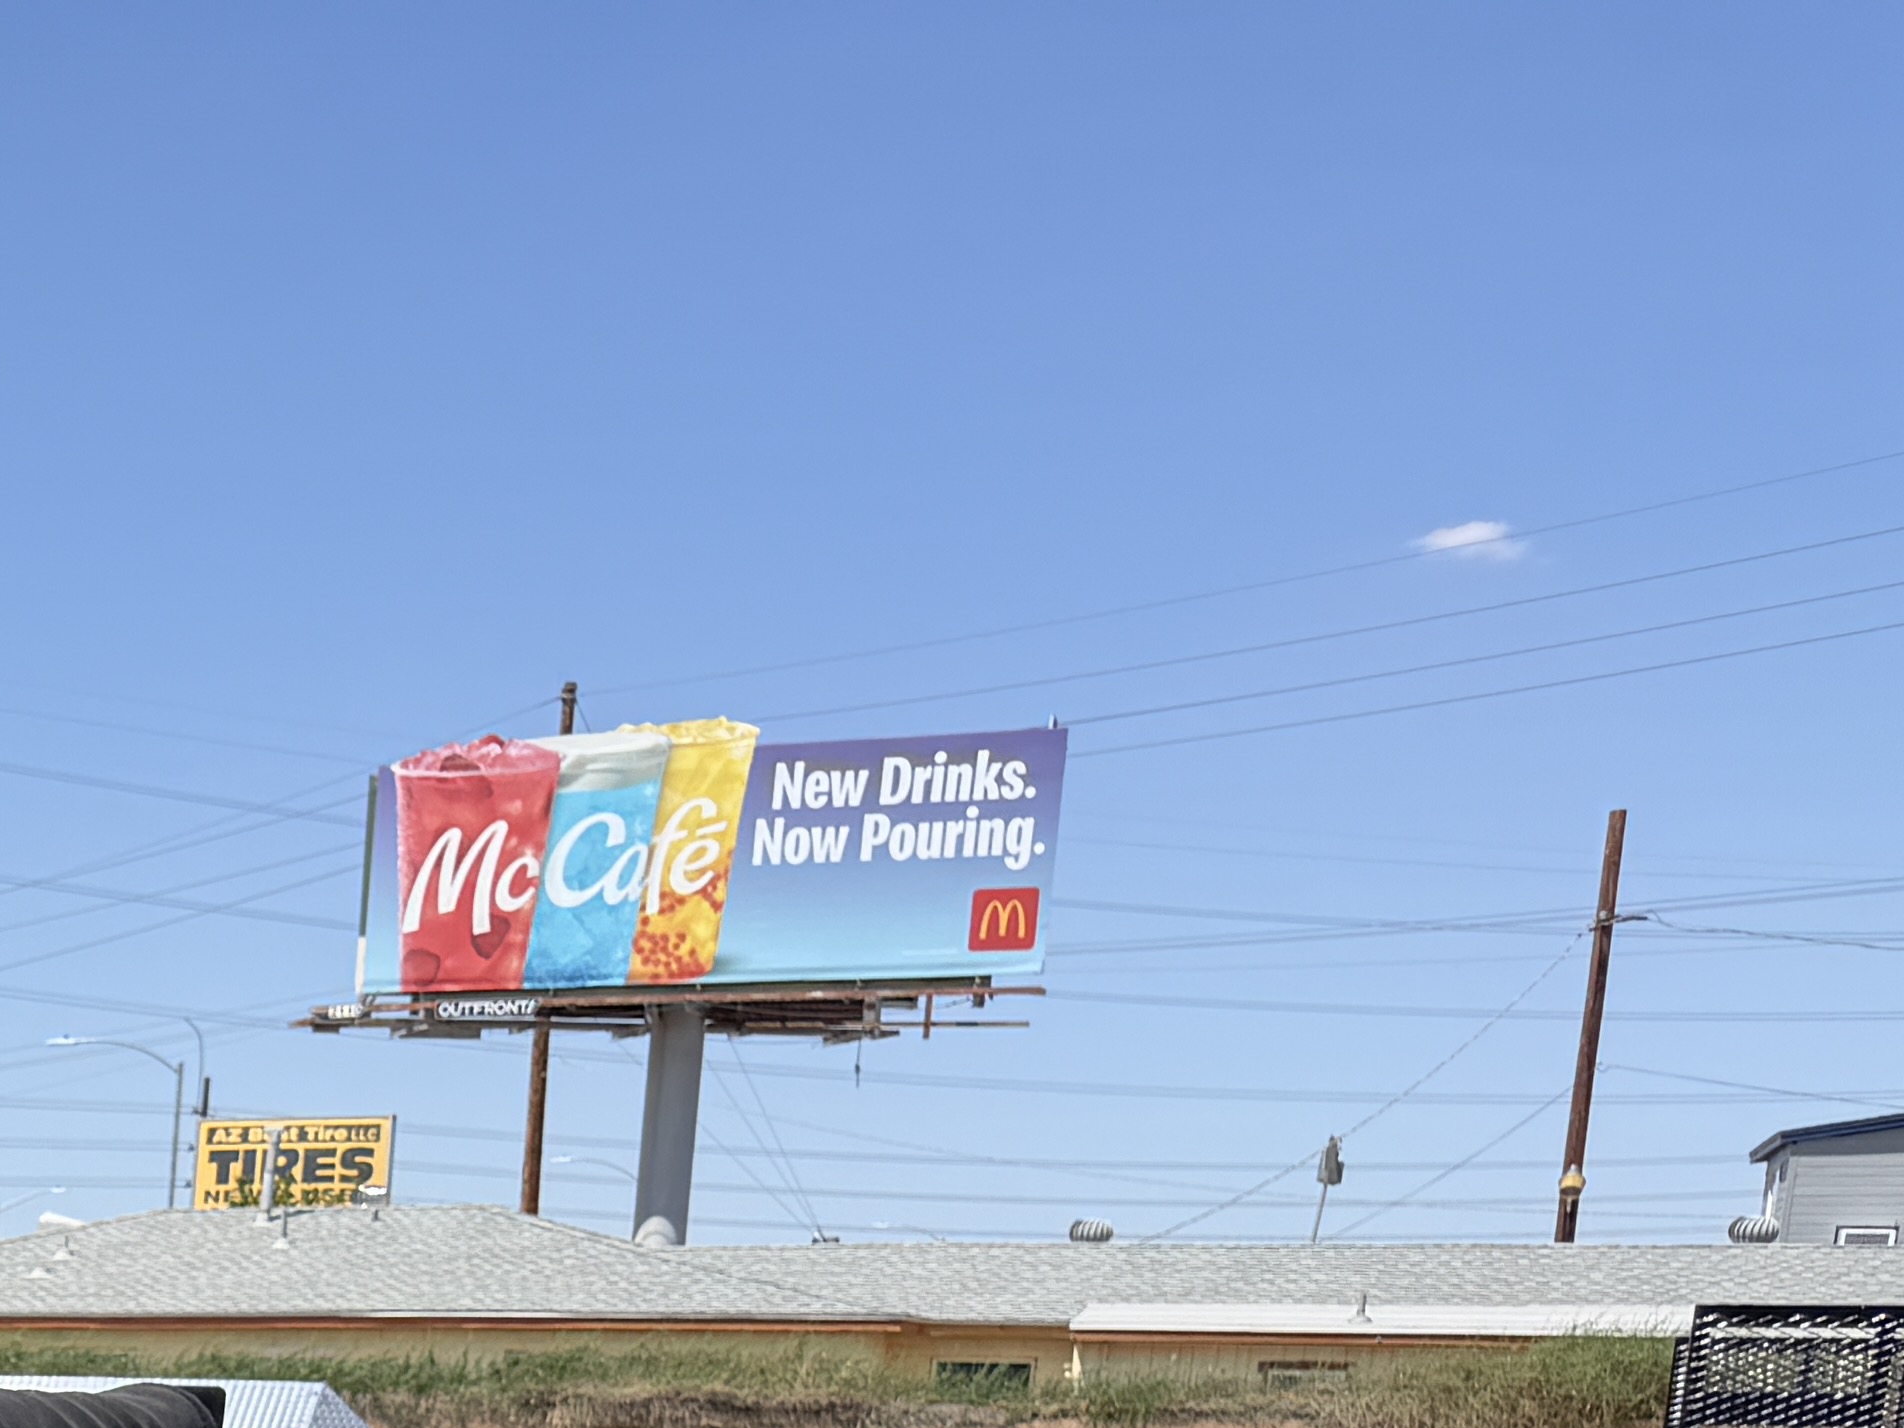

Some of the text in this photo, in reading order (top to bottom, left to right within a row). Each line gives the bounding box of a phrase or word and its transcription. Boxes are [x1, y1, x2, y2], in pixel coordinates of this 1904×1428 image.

[771, 749, 1037, 810] New Drinks.
[402, 796, 733, 937] McCafé
[751, 805, 1046, 871] Now Pouring.
[212, 1128, 243, 1144] AZ
[350, 1127, 378, 1142] LLC
[208, 1147, 375, 1186] TIRES
